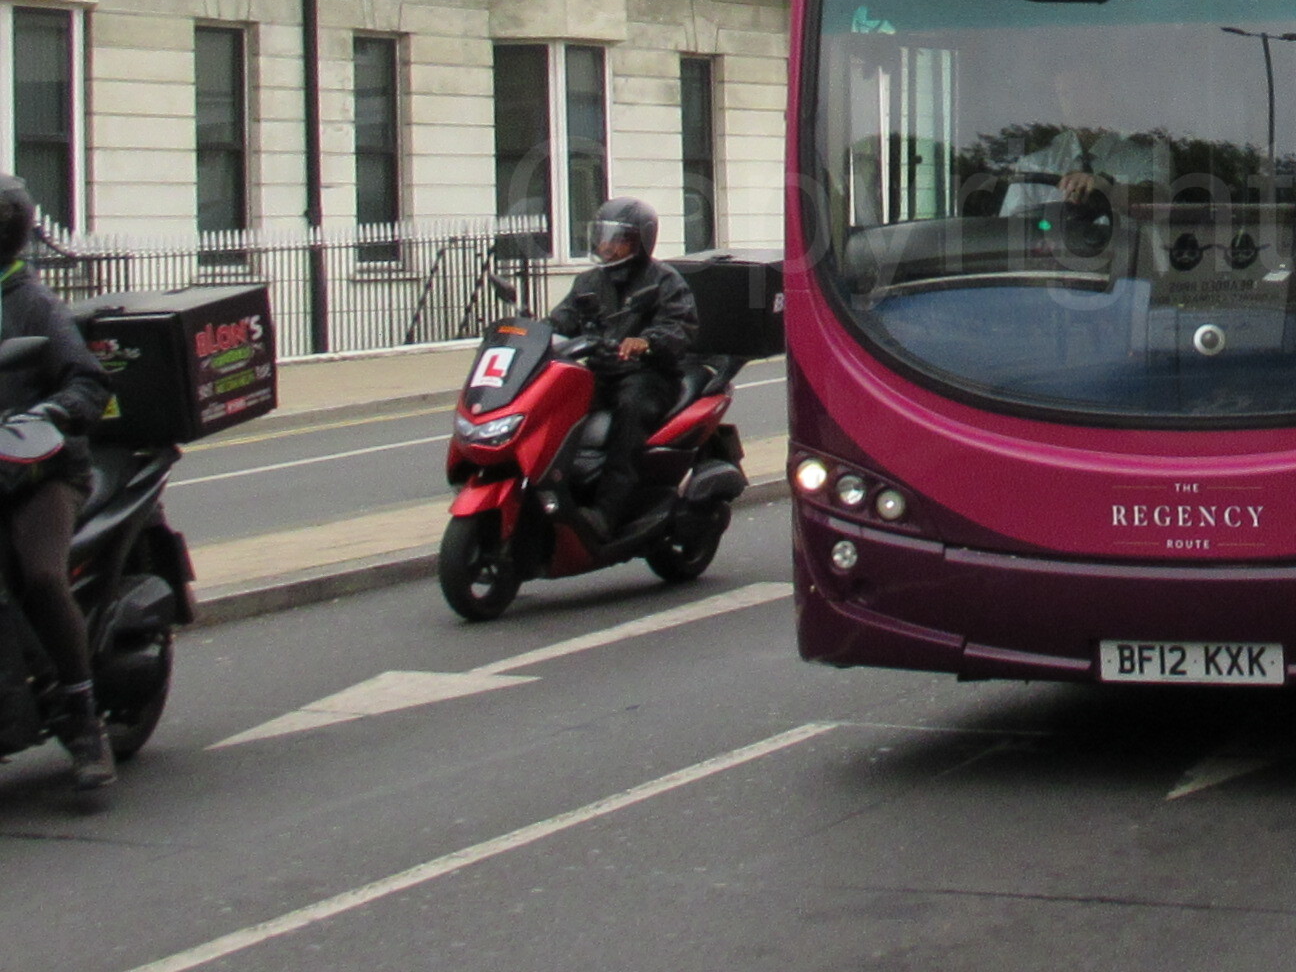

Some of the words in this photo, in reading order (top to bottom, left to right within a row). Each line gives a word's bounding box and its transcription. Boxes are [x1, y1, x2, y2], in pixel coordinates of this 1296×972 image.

[1174, 482, 1200, 493] THE
[1111, 504, 1264, 528] REGENCY
[1166, 539, 1211, 550] ROUTE
[1117, 643, 1188, 676] BF12
[1204, 645, 1267, 677] KXK
